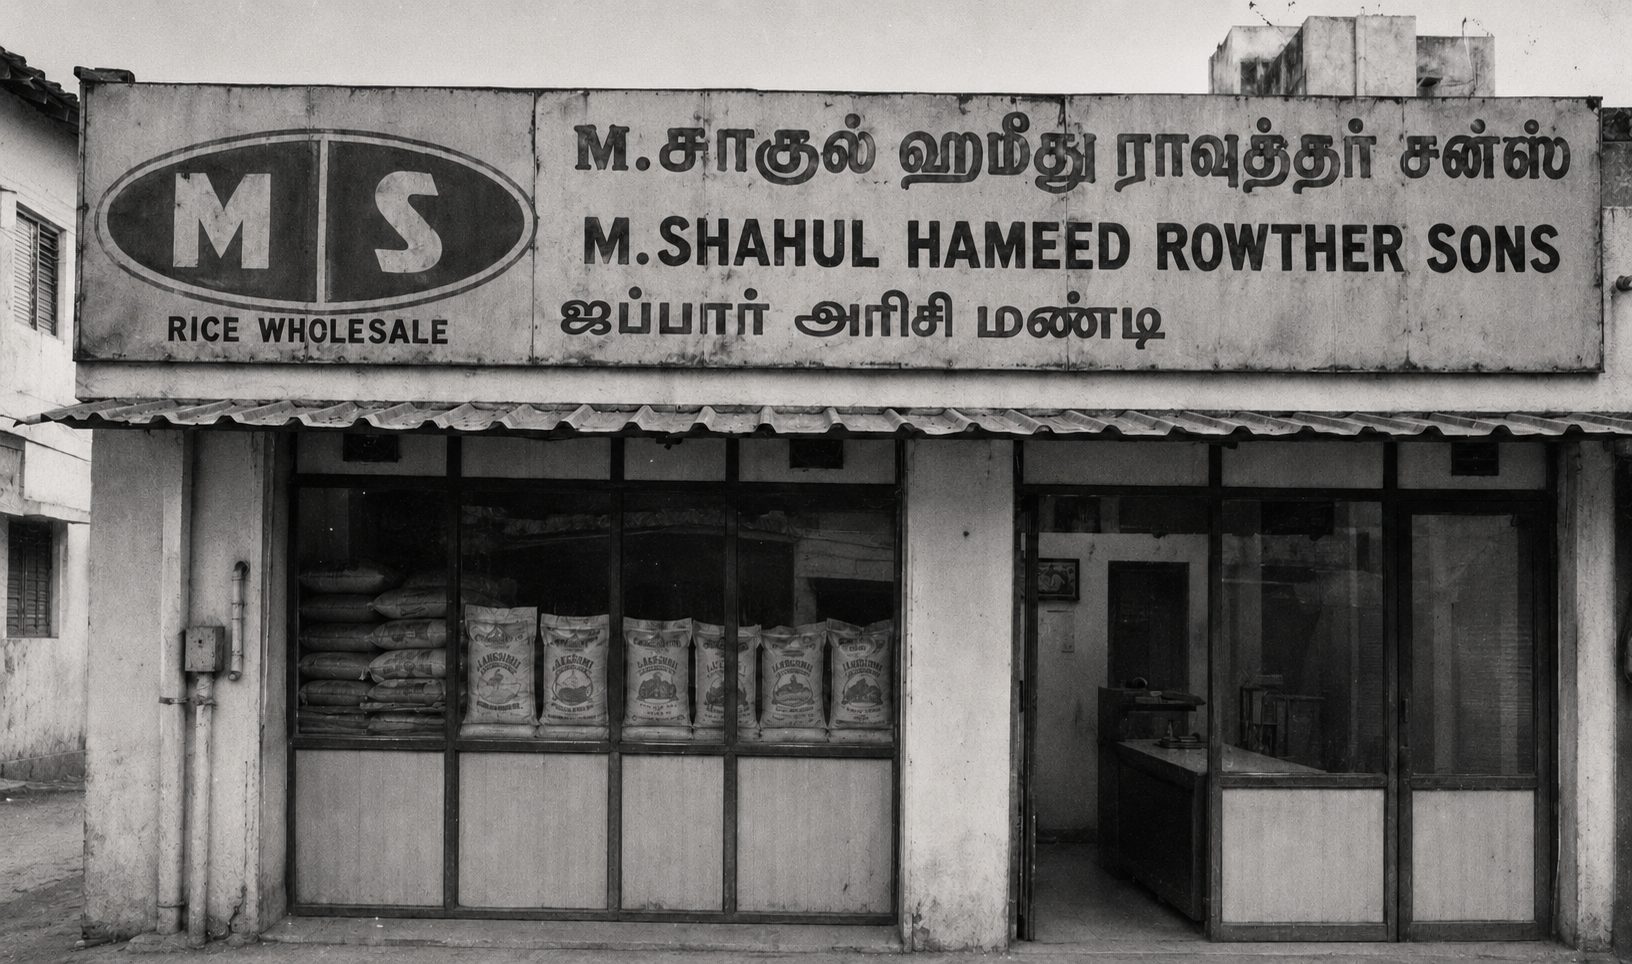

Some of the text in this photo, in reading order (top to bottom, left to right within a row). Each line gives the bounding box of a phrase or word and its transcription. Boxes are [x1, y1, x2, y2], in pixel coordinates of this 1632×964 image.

[899, 111, 1096, 194] ஹமீது
[1115, 117, 1377, 194] ராவுத்தர்
[1400, 119, 1570, 180] சன்ஸ்
[173, 171, 443, 273] M S
[908, 220, 1130, 270] HAMEED
[1157, 223, 1404, 273] ROWTHER
[1427, 223, 1560, 273] SONS
[168, 316, 448, 345] RICE WHOLESALE
[561, 286, 1165, 350] ஜப்பார் அரிசி மண்டி
